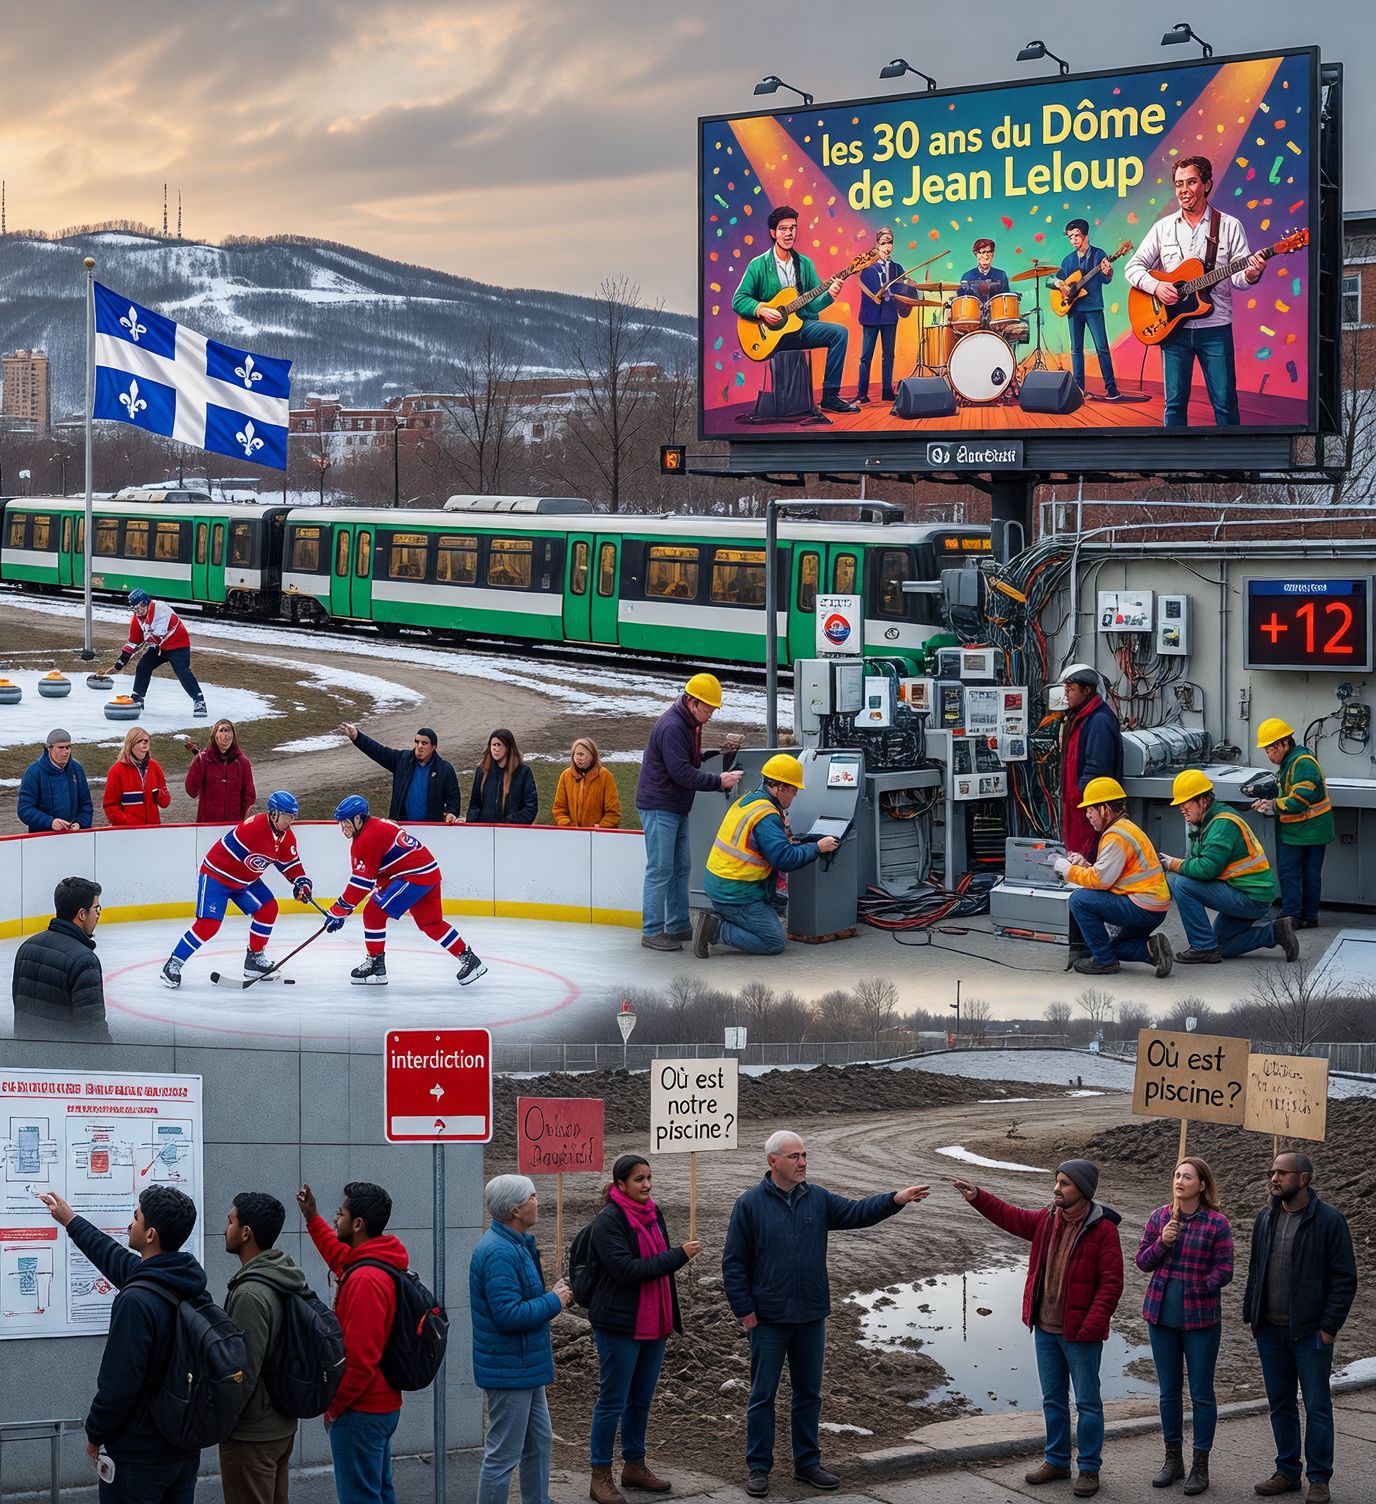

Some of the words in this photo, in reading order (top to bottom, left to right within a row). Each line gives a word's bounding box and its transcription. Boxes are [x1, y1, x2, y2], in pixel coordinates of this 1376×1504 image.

[822, 133, 864, 167] les
[872, 120, 921, 162] 30
[928, 128, 983, 156] ans
[991, 115, 1031, 150] du
[1041, 98, 1166, 145] Dôme
[847, 168, 894, 211] de
[901, 165, 992, 206] Jean
[1004, 150, 1144, 198] Leloup
[391, 1049, 485, 1069] interdiction
[1187, 1045, 1226, 1072] est
[660, 1065, 689, 1091] Où
[695, 1066, 725, 1090] est
[1145, 1076, 1242, 1109] piscine?
[668, 1093, 718, 1115] notre
[656, 1112, 735, 1150] piscine?
